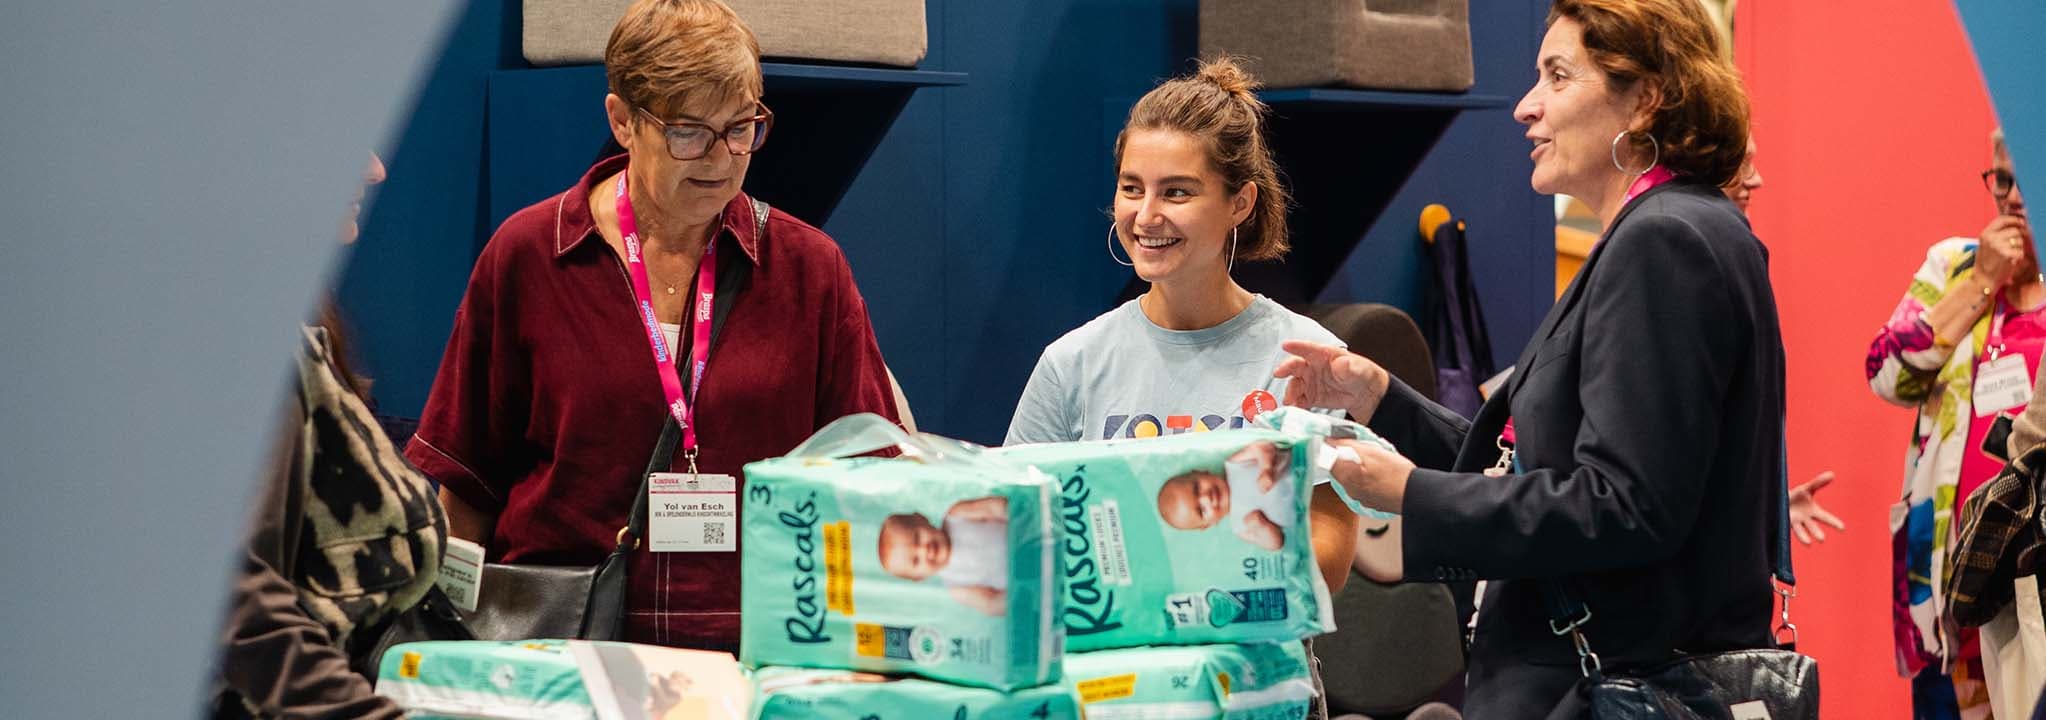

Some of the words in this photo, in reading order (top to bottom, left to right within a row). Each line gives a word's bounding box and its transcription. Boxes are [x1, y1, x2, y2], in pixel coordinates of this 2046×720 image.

[750, 484, 772, 505] 3
[664, 502, 679, 511] Yol
[681, 503, 698, 511] van
[701, 502, 725, 511] Esch
[1242, 557, 1258, 582] 40
